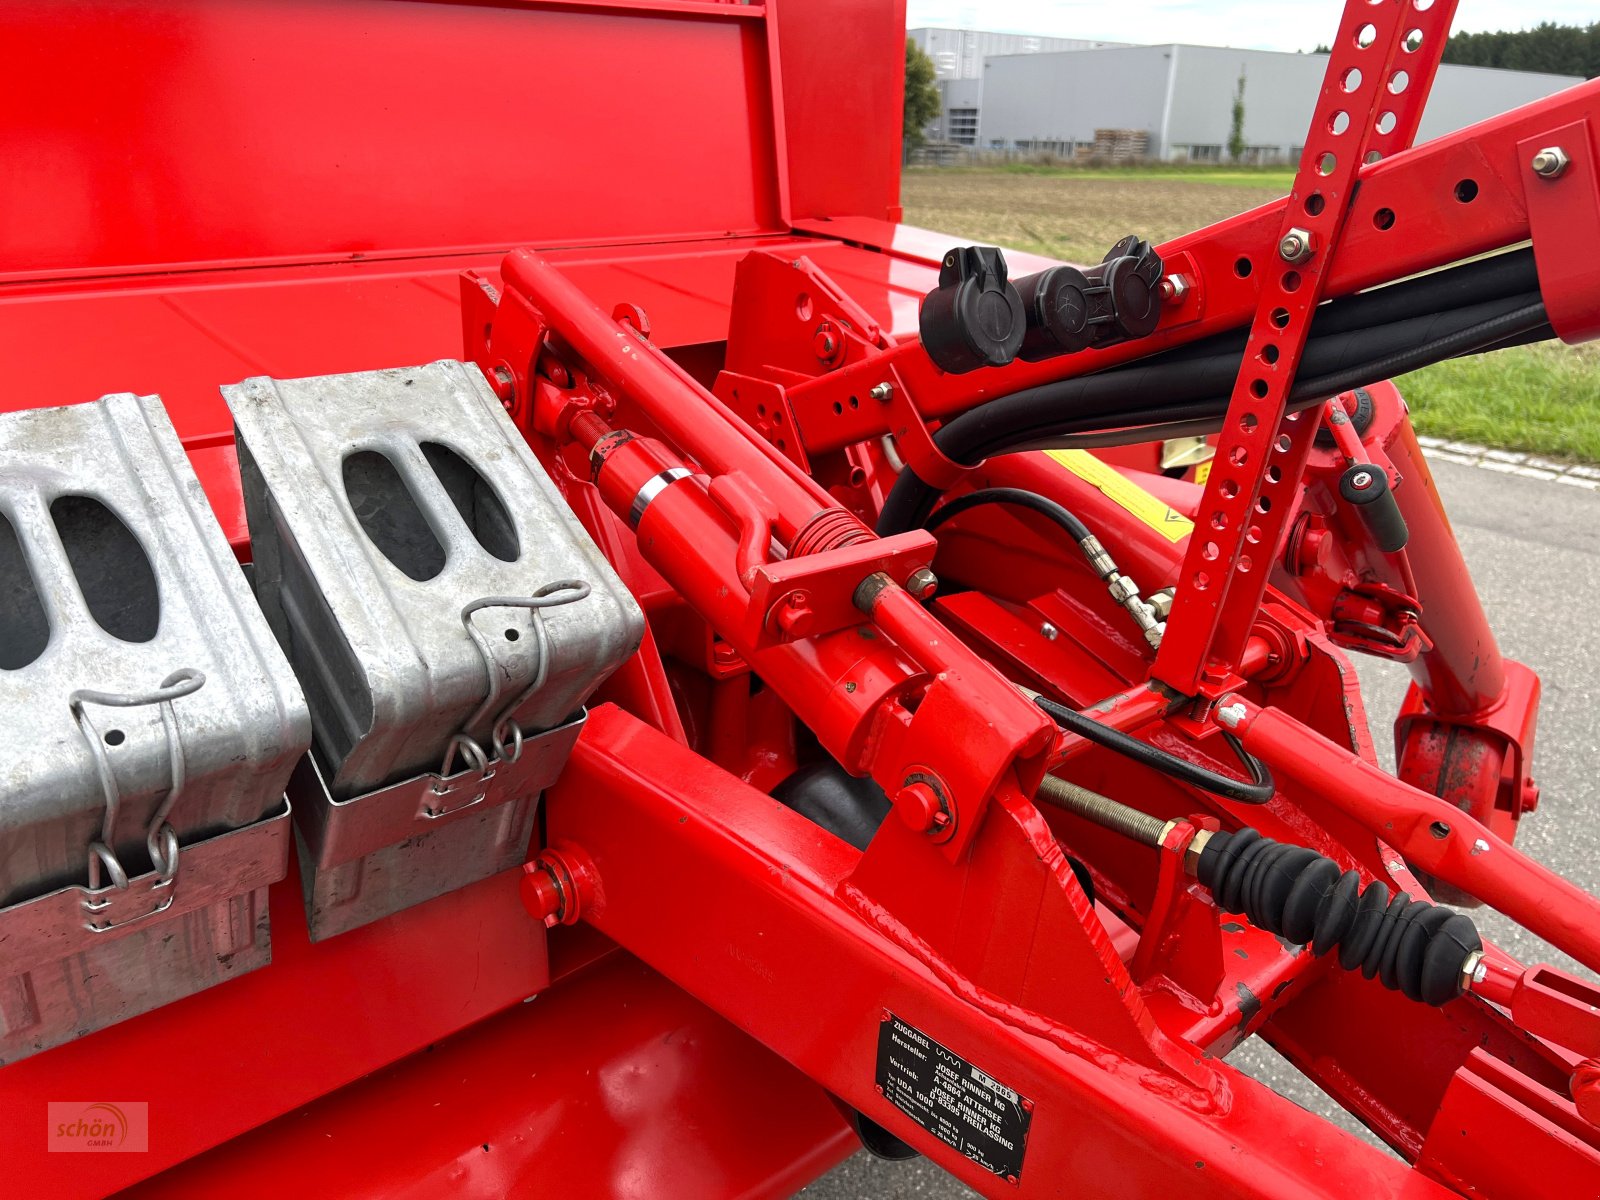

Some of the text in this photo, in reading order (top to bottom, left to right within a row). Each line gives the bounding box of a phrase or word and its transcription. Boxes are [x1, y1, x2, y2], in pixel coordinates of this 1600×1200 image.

[891, 1033, 927, 1062] Hersteller:
[893, 1020, 930, 1050] ZUGGABEL
[889, 1056, 919, 1082] Vertrieb:
[978, 1073, 986, 1083] M
[897, 1077, 913, 1094] UDA
[916, 1091, 933, 1107] 1000
[933, 1076, 1002, 1124] A-4864 ATTERSEE
[936, 1063, 1006, 1111] JOSEF RINNER KG
[929, 1092, 1014, 1151] D-83395 FREILASSING
[932, 1086, 1001, 1134] JOSEF RINNER KG
